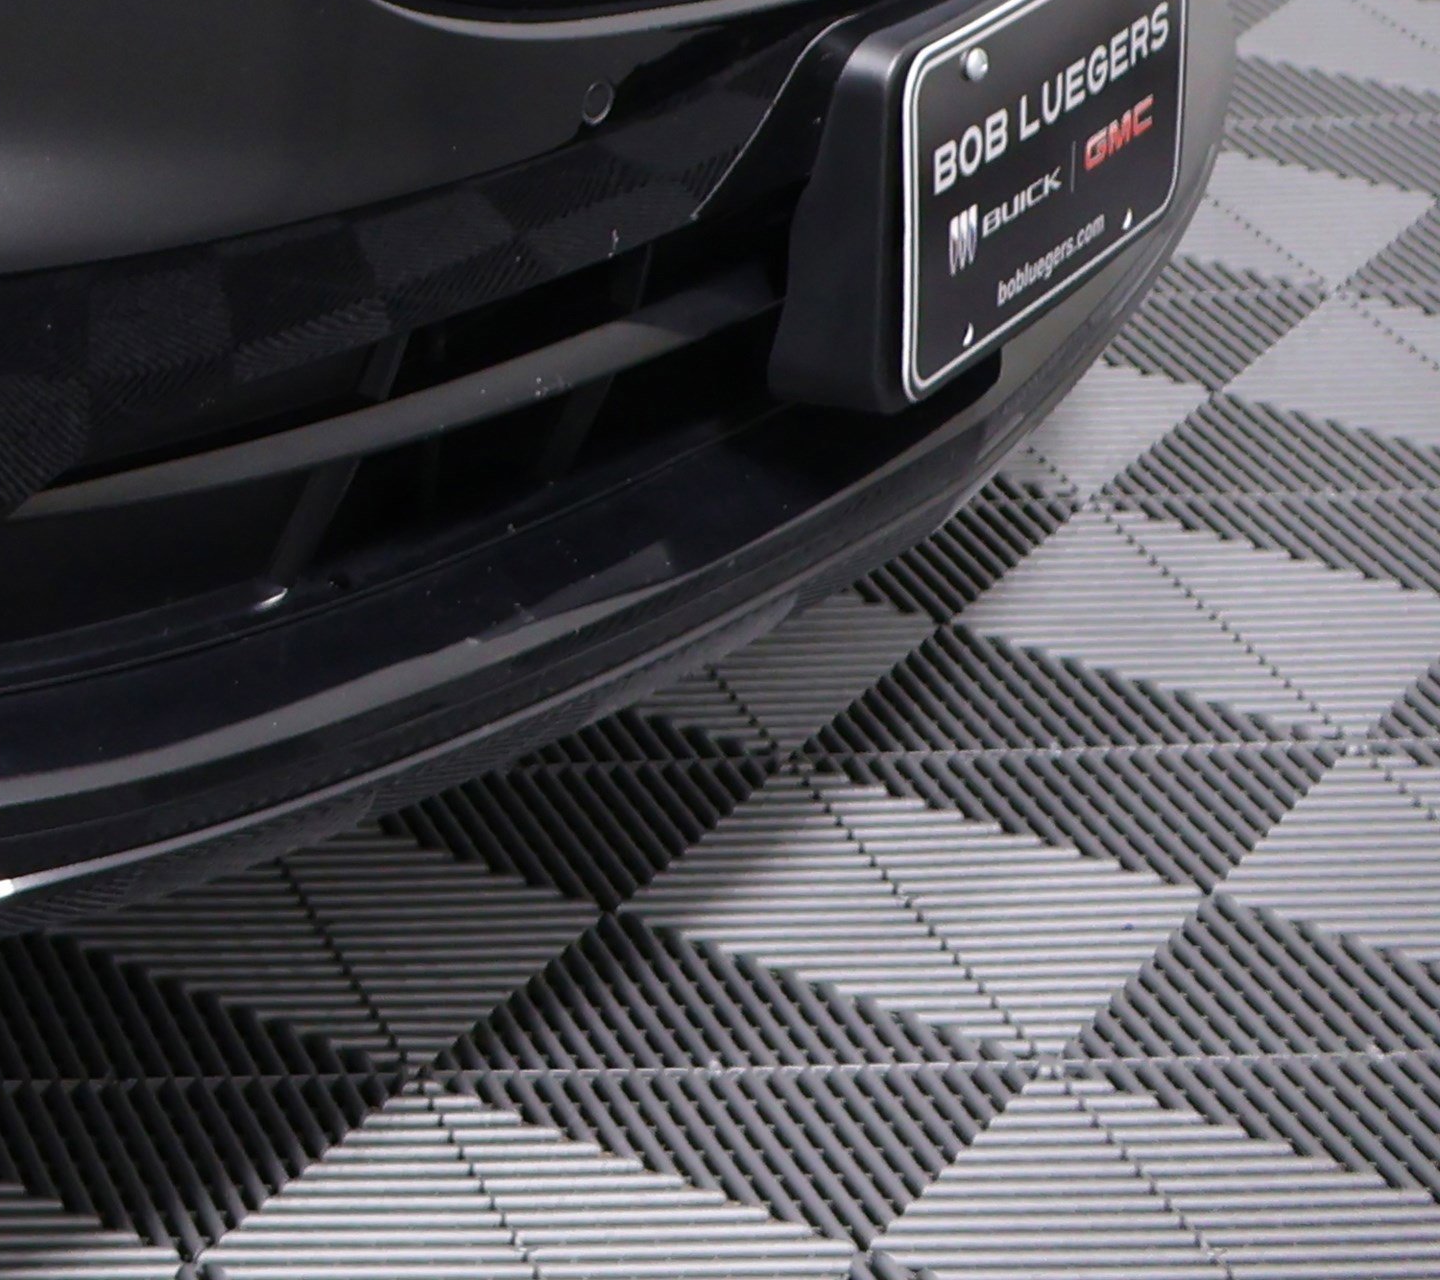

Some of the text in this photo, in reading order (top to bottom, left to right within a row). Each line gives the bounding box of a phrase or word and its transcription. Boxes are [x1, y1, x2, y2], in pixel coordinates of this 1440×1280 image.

[933, 1, 1169, 196] BOB LUEGERS
[1084, 93, 1155, 172] GMC
[982, 166, 1063, 239] BUICK
[996, 213, 1106, 308] bobluegers.com
